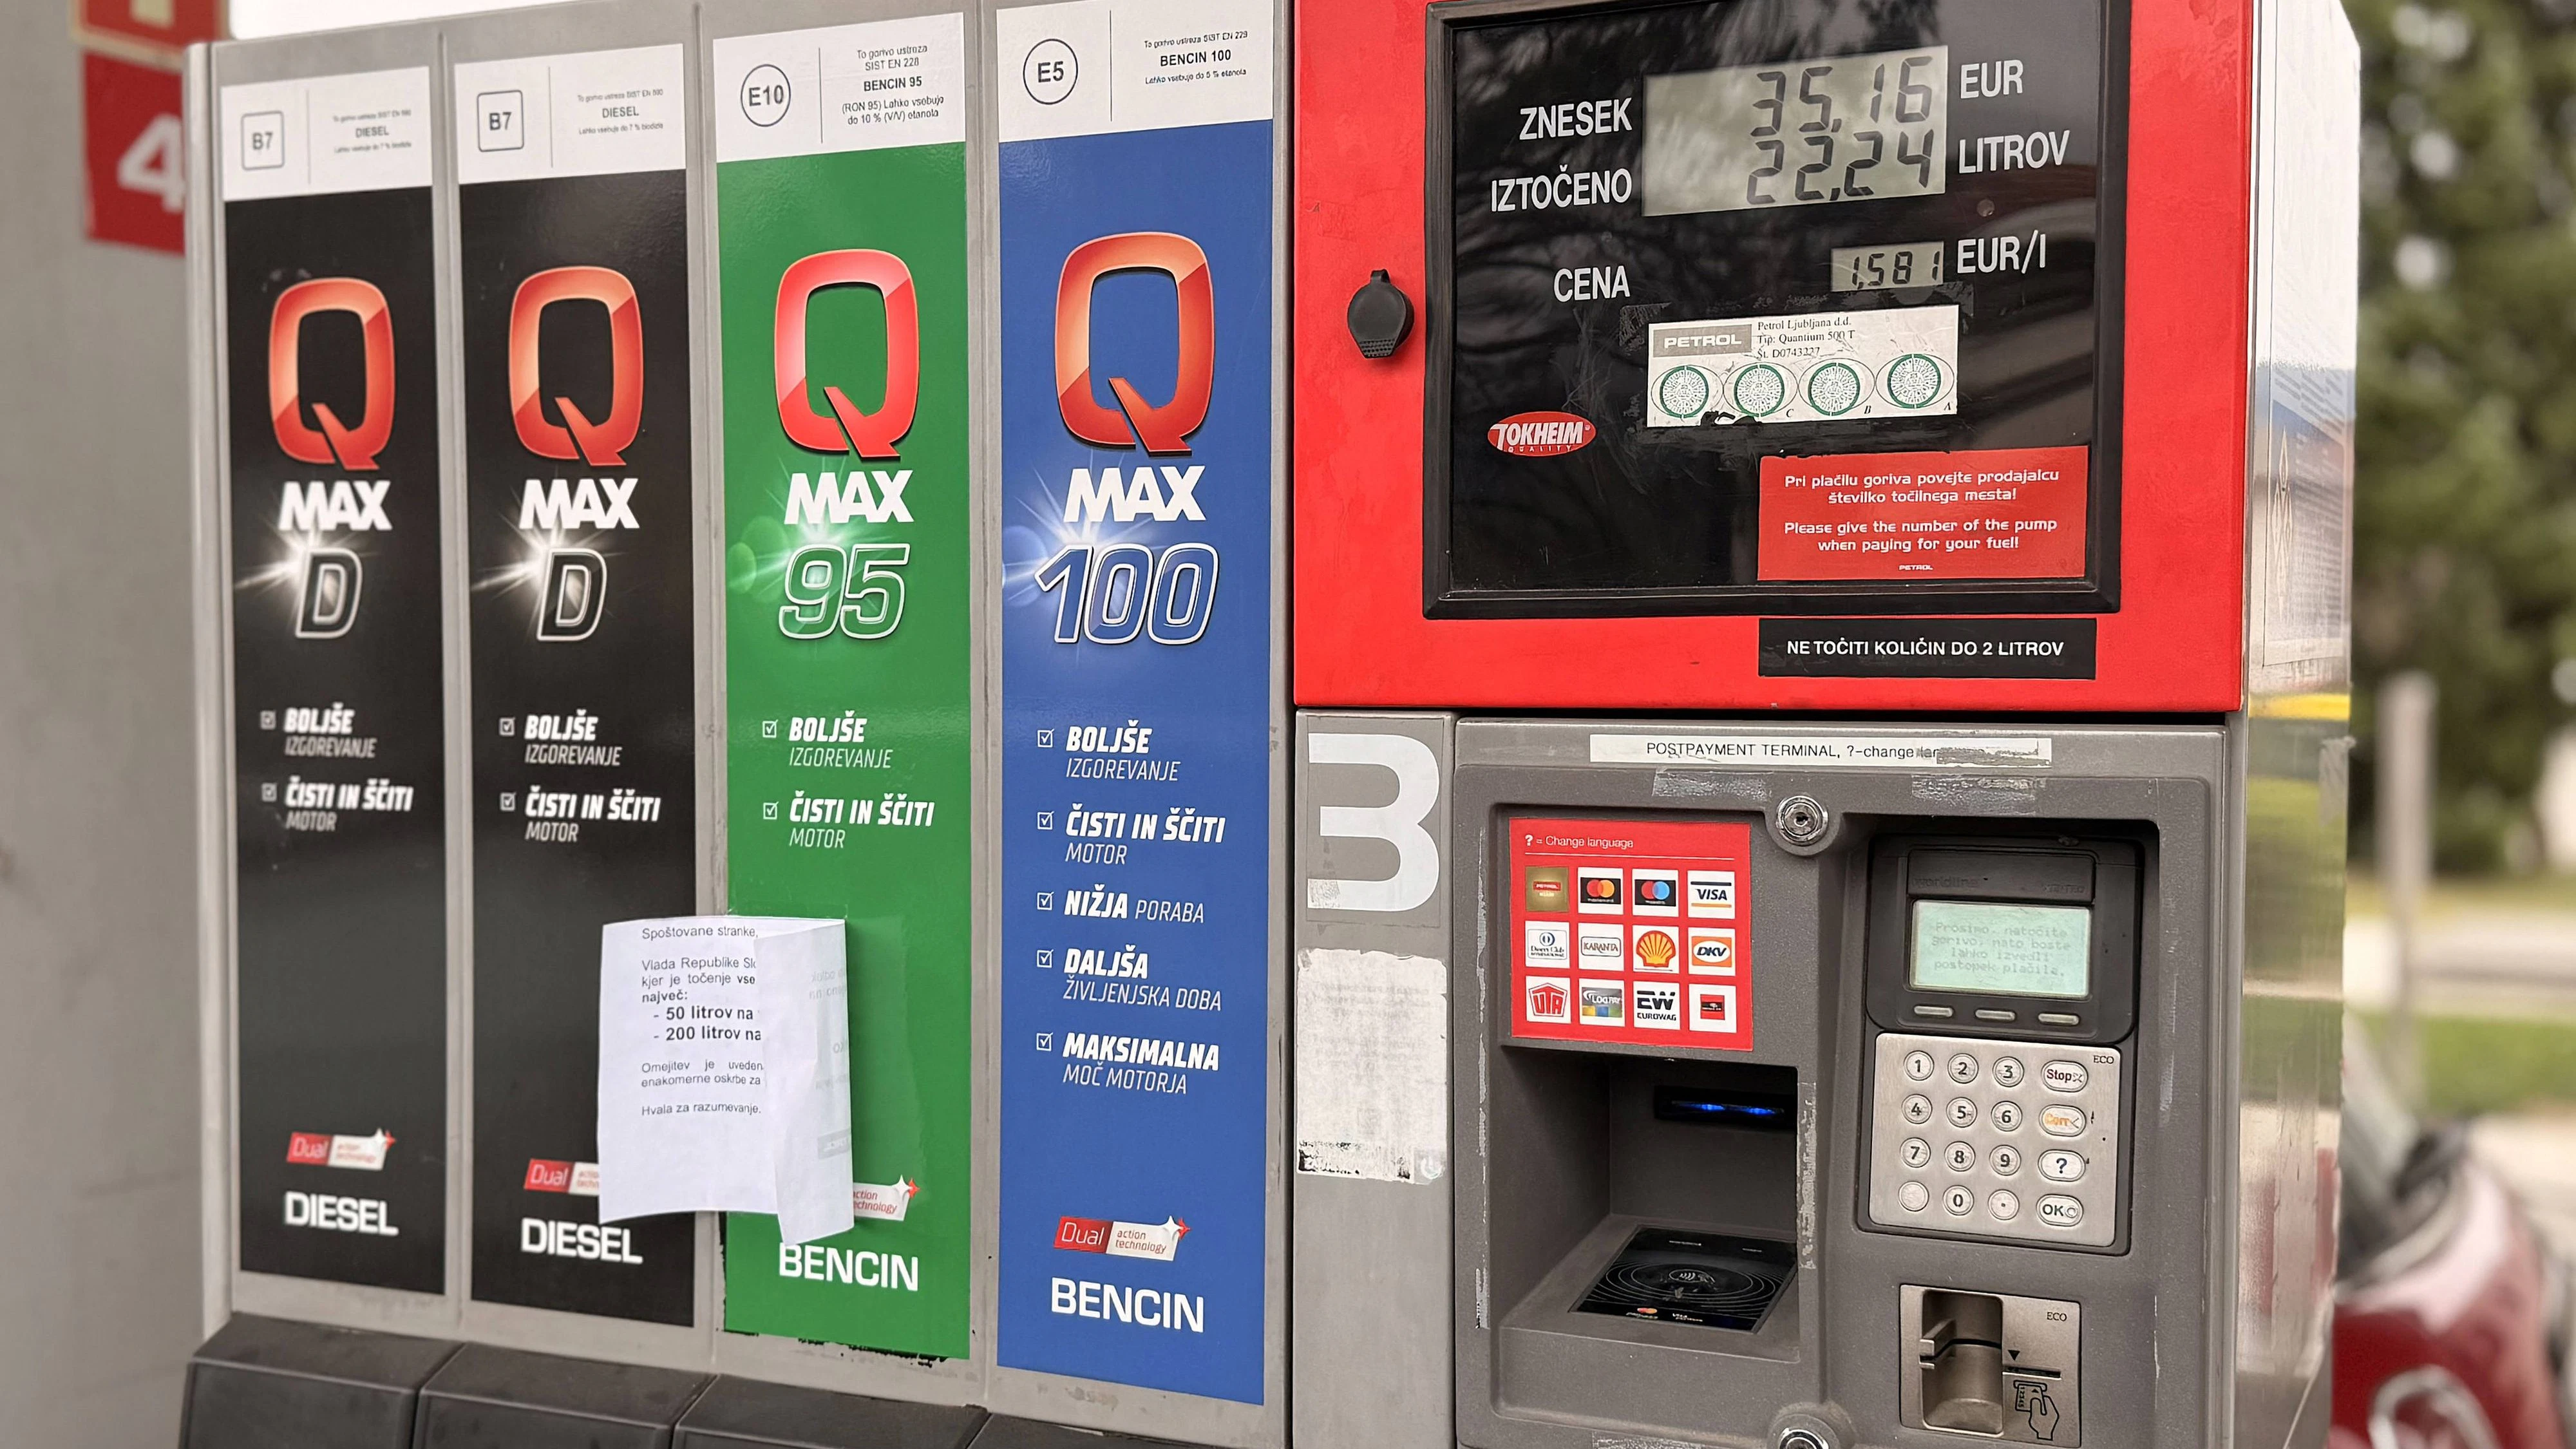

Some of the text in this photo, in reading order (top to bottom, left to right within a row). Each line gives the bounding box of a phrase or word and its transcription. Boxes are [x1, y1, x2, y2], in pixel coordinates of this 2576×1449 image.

[1160, 49, 1231, 66] BENCIN 100
[1037, 61, 1065, 82] E5
[1960, 59, 2024, 100] EUR
[864, 76, 922, 91] BENCIN 95
[749, 84, 784, 106] E10
[1750, 54, 1933, 137] 35,16
[489, 111, 511, 131] B7
[602, 106, 639, 118] DIESEL
[1519, 98, 1633, 141] ZNESEK
[252, 131, 272, 150] B7
[355, 126, 389, 137] DIESEL
[1958, 129, 2070, 175] LITROV
[1746, 128, 1935, 206] 22,24
[1490, 164, 1633, 213] IZTOČENO
[1850, 245, 1942, 290] 1,581
[1553, 265, 1631, 303] CENA
[1757, 316, 1852, 331] Petrol Ljubljana d.d.
[1055, 232, 1215, 456] Q
[1663, 334, 1742, 349] PETROL
[1757, 335, 1776, 346] Tip:
[1779, 333, 1824, 345] Quantium
[1848, 330, 1855, 339] T
[773, 248, 920, 459] Q
[269, 278, 395, 471] Q
[509, 266, 643, 466] Q
[1490, 422, 1584, 451] TOKHEIM
[1785, 468, 2060, 489] Pri plačilu goriva povejte prodajalcu
[519, 478, 639, 529] MAX
[784, 470, 914, 524] MAX
[1063, 465, 1206, 522] MAX
[1828, 488, 2016, 505] številko točilnega mesta!
[278, 480, 392, 531] MAX
[1784, 518, 2058, 536] Please give the number of the pump
[1817, 536, 2020, 554] when paying for your fuel!
[296, 547, 362, 638] D
[537, 548, 607, 641] D
[779, 543, 910, 639] 95
[1034, 542, 1218, 644] 100
[1787, 637, 2064, 656] NE TOČITI KOLIČIN DO 2 LITROV
[283, 703, 355, 735] BOLJŠE
[524, 710, 598, 741] BOLJŠE
[789, 710, 867, 743] BOLJŠE
[285, 735, 377, 758] IZGOREVANJE
[1065, 719, 1152, 754] BOLJŠE
[526, 744, 622, 766] IZGOREVANJE
[789, 747, 893, 769] IZGOREVANJE
[1647, 742, 1754, 757] POSTPAYMENT
[1761, 744, 1841, 759] TERMINAL,
[1847, 744, 1914, 761] ?-change
[1065, 758, 1180, 782] IZGOREVANJE
[285, 775, 413, 811] ČISTI IN ŠČITI
[526, 786, 661, 822] ČISTI IN ŠČITI
[789, 790, 934, 827] ČISTI IN ŠČITI
[285, 811, 337, 831] MOTOR
[526, 822, 578, 842] MOTOR
[1065, 802, 1226, 843] ČISTI IN ŠČITI
[1307, 733, 1440, 912] 3
[789, 828, 846, 849] MOTOR
[1525, 835, 1633, 850] ? Change language
[1065, 842, 1127, 864] MOTOR
[1064, 884, 1204, 923] NIŽJA PORABA
[1695, 889, 1727, 900] VISA
[642, 925, 758, 941] Spoštovane stranke,
[1584, 942, 1618, 952] KARANTA
[1696, 947, 1727, 956] DKV
[642, 956, 739, 971] Vlada Republike
[1063, 943, 1148, 979] DALJŠA
[642, 975, 663, 989] kjer
[670, 974, 681, 987] je
[688, 972, 731, 985] točenje
[642, 989, 688, 1005] največ:
[1063, 974, 1222, 1011] ŽIVLJENJSKA DOBA
[1532, 986, 1565, 1014] UTA
[1637, 990, 1676, 1010] EW
[666, 1005, 753, 1020] 50 litrov na
[1637, 1012, 1676, 1021] EUROWAG
[665, 1025, 761, 1041] 200 litrov na
[1062, 1032, 1219, 1071] MAKSIMALNA
[2093, 1055, 2114, 1065] ECO
[641, 1059, 715, 1074] Omejitev je
[2046, 1069, 2072, 1083] Stop
[641, 1074, 761, 1088] enakomerne oskrbe za
[1063, 1061, 1187, 1095] MOČ MOTORJA
[641, 1103, 761, 1116] Hvala za razumevanje.
[293, 1137, 328, 1158] Dual
[530, 1164, 569, 1186] Dual
[284, 1191, 399, 1236] DIESEL
[520, 1218, 643, 1264] DIESEL
[1061, 1222, 1104, 1245] Dual
[1117, 1229, 1146, 1239] action
[1115, 1240, 1166, 1255] technology
[779, 1243, 918, 1291] BENCIN
[1051, 1277, 1204, 1333] BENCIN
[2047, 1311, 2067, 1321] ECO
